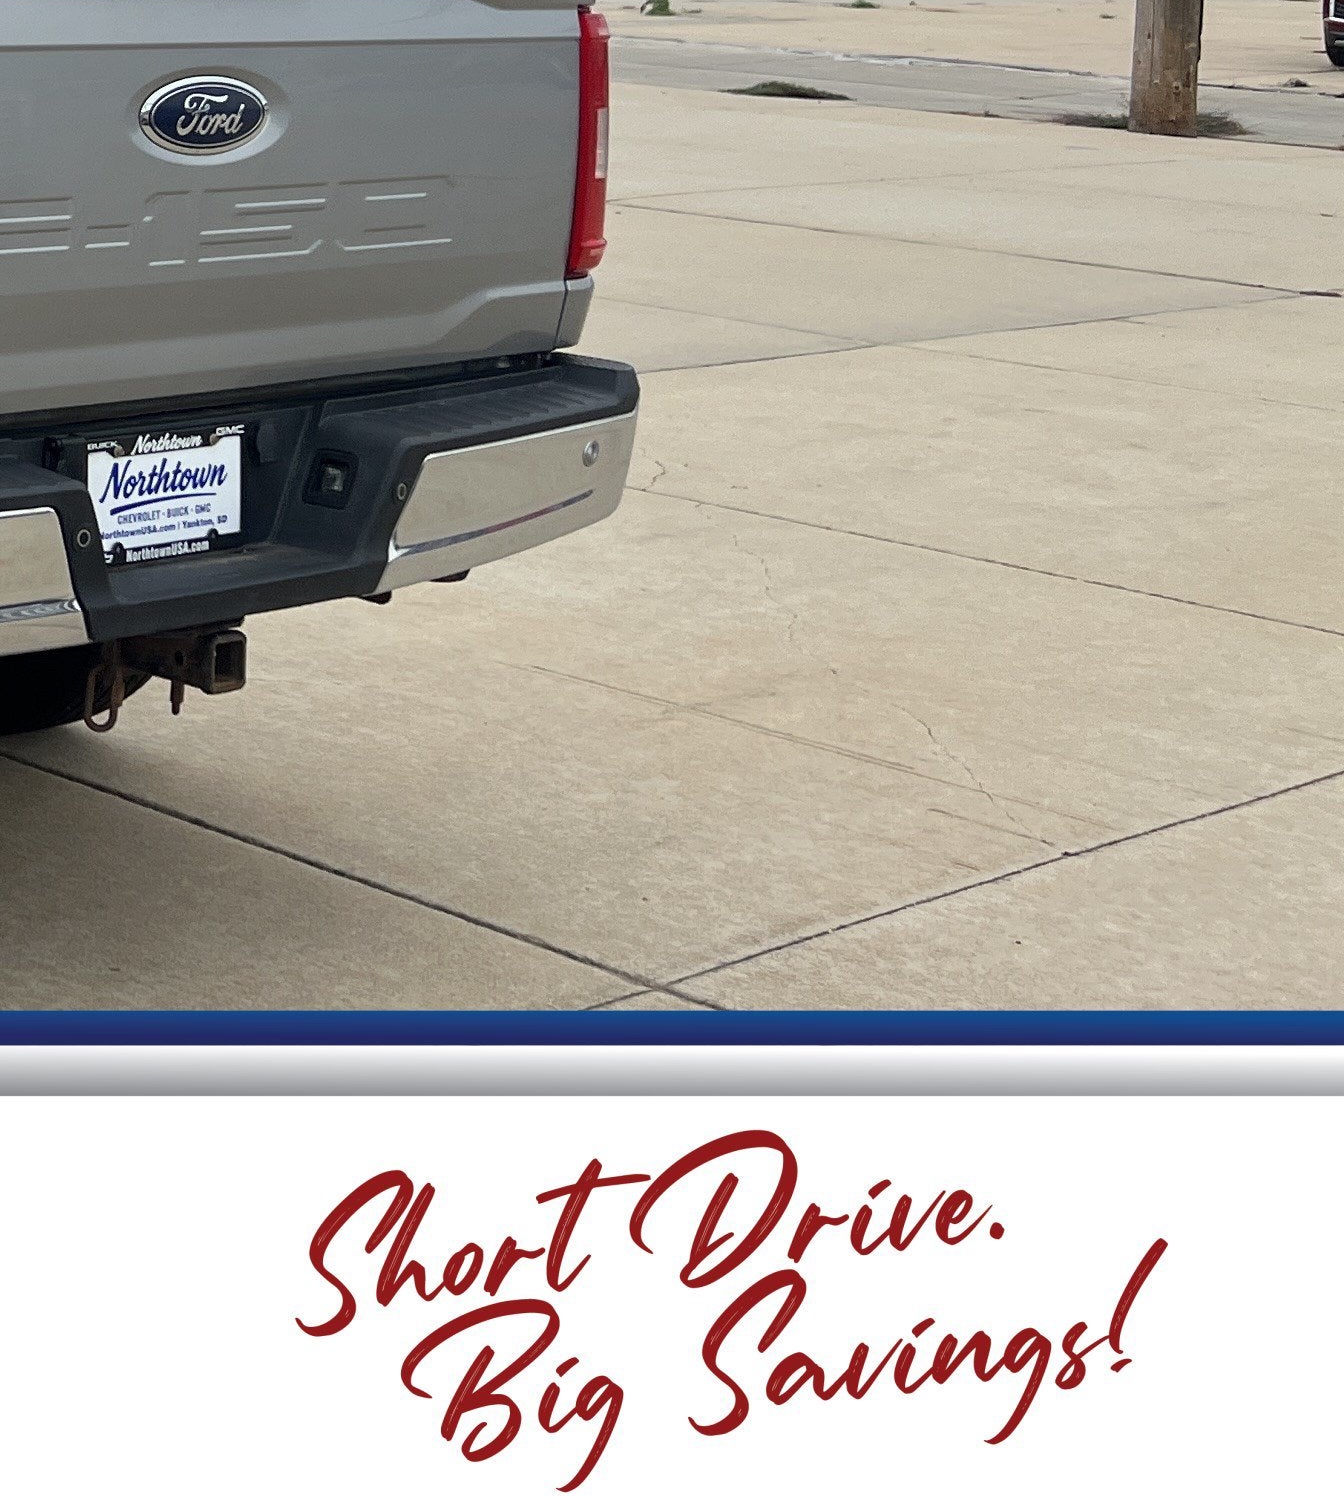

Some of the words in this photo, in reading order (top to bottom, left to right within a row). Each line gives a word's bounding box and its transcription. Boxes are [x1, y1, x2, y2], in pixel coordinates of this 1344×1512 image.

[176, 93, 246, 136] Ford
[130, 432, 203, 456] Northtown
[216, 424, 245, 436] GMC
[99, 457, 227, 503] Northtown
[117, 509, 161, 525] CHEVROLET
[126, 540, 210, 563] NorthtownUSA.com
